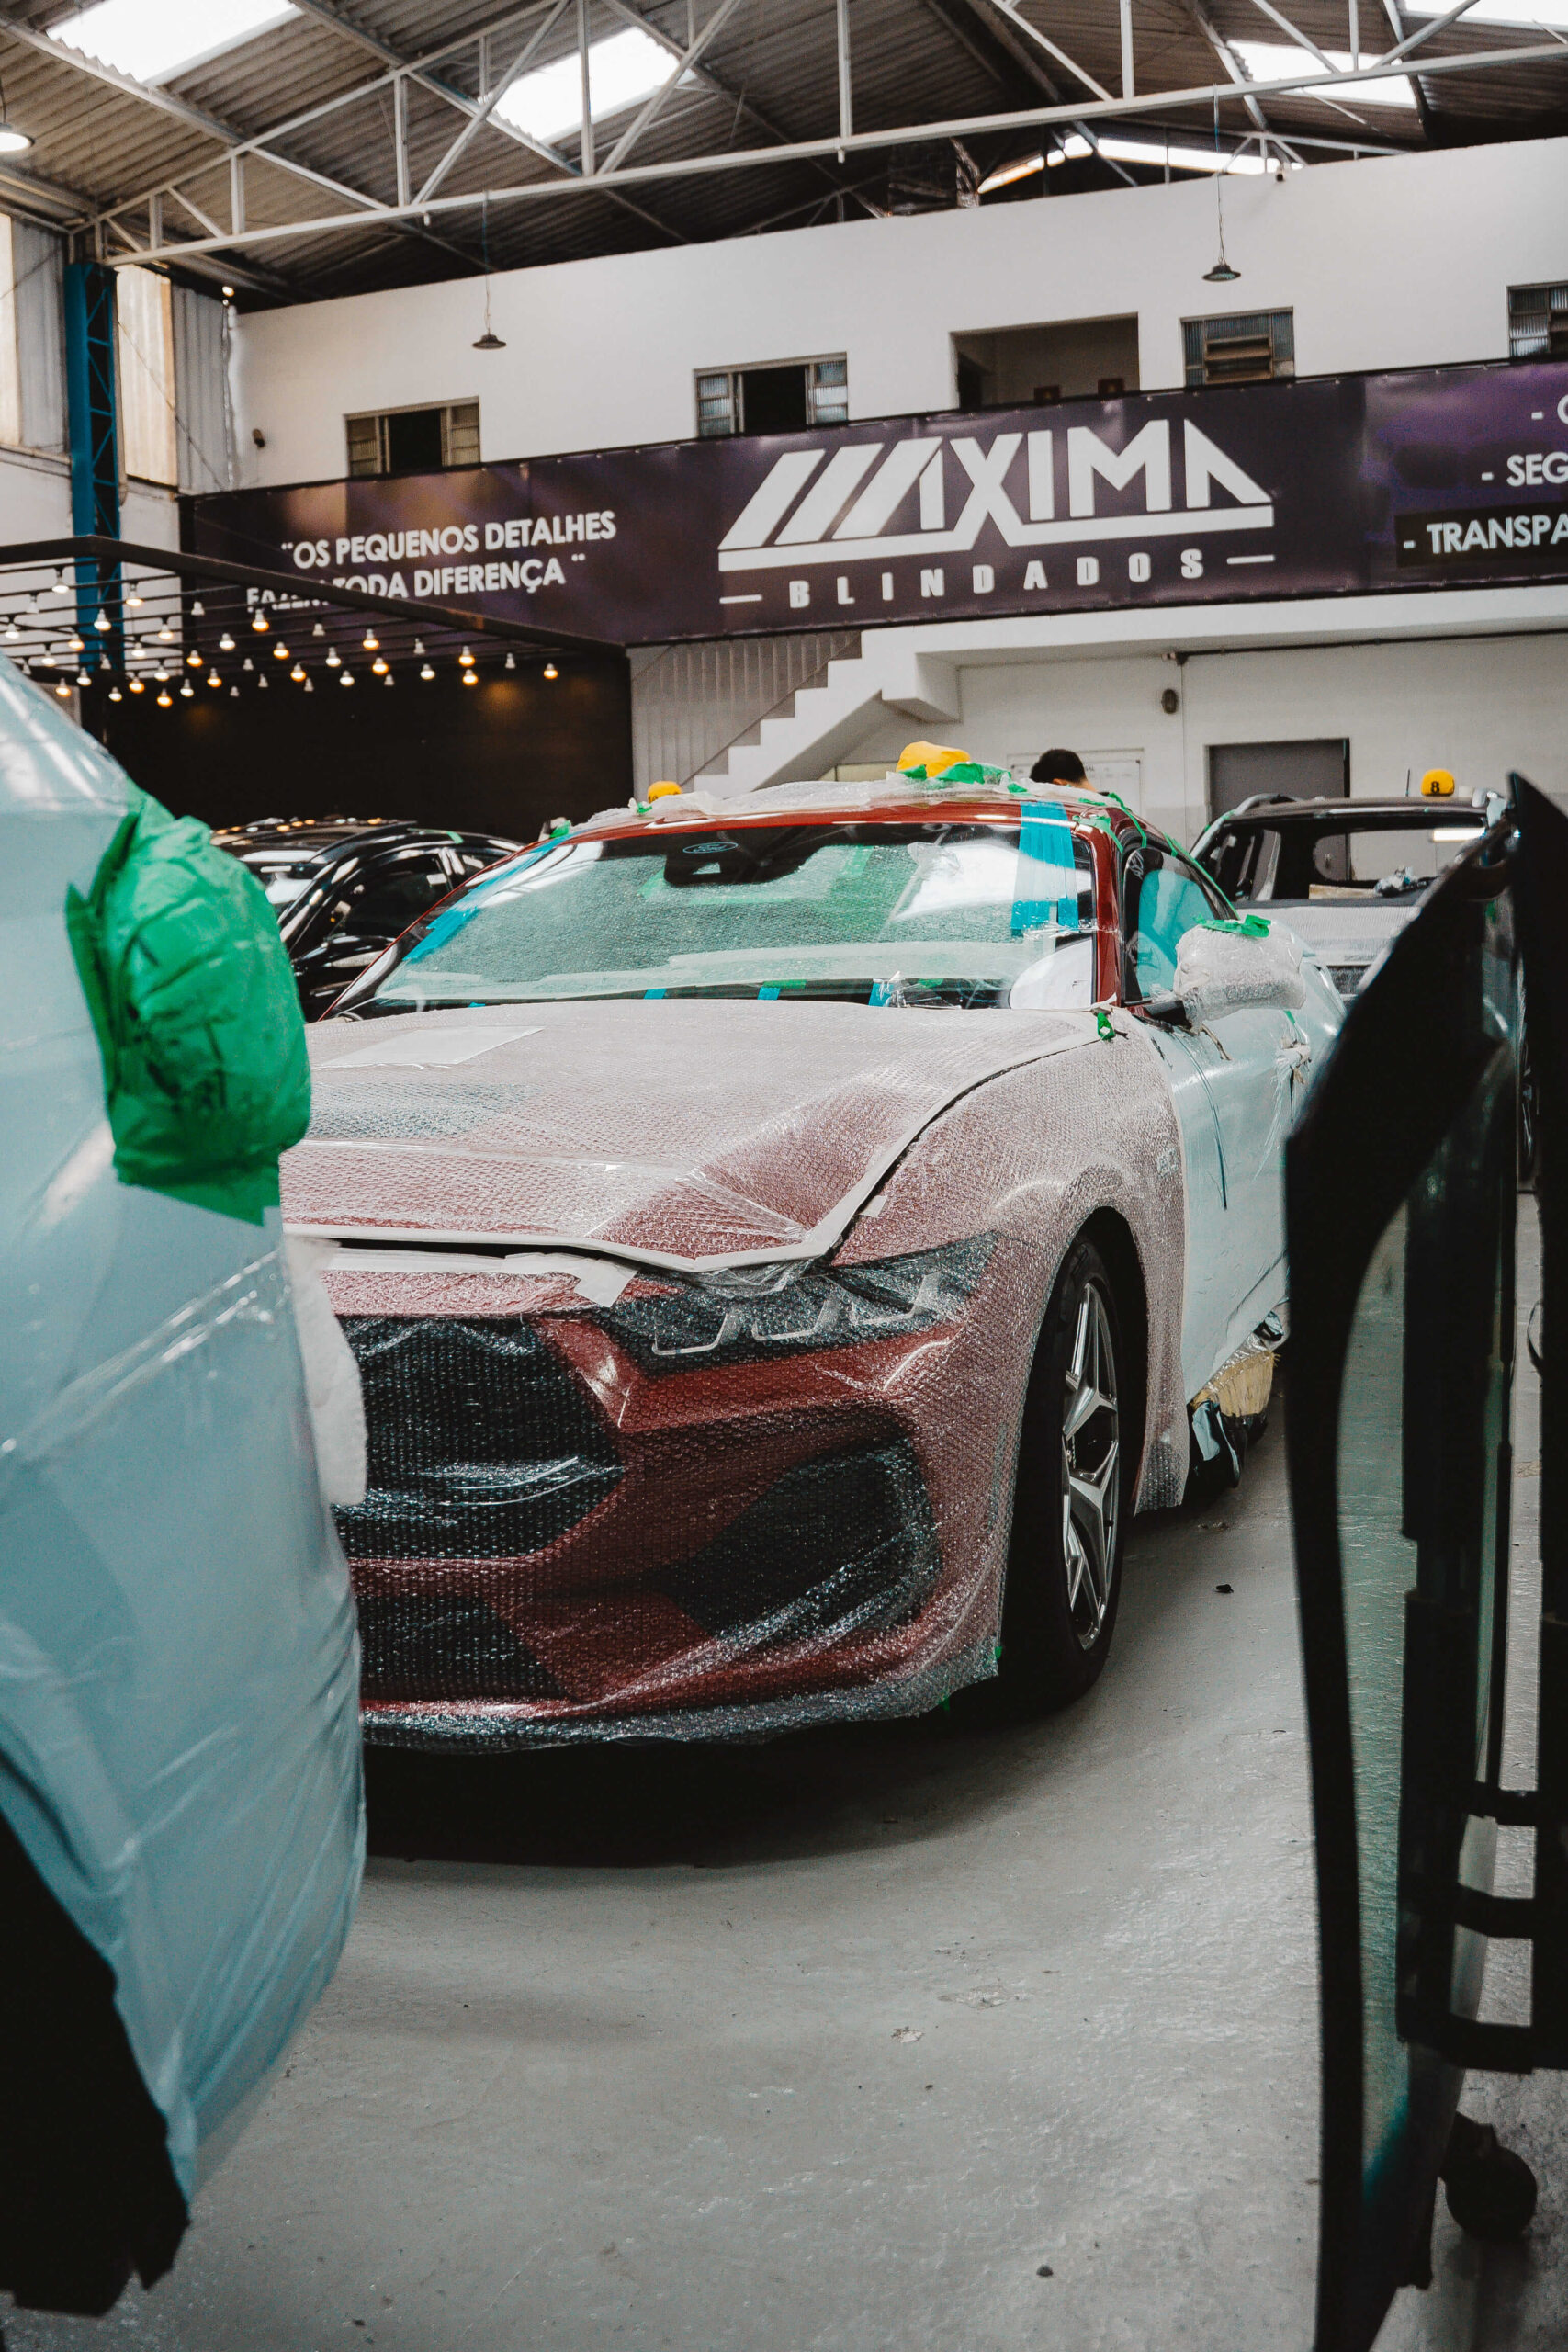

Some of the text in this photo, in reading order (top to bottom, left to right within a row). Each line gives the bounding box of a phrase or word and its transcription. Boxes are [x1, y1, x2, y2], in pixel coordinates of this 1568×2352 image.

[335, 524, 479, 565] PEQUENOS
[484, 510, 617, 550] DETALHES
[413, 557, 567, 598] DIFERENÇA
[788, 548, 1204, 609] BLINDADOS
